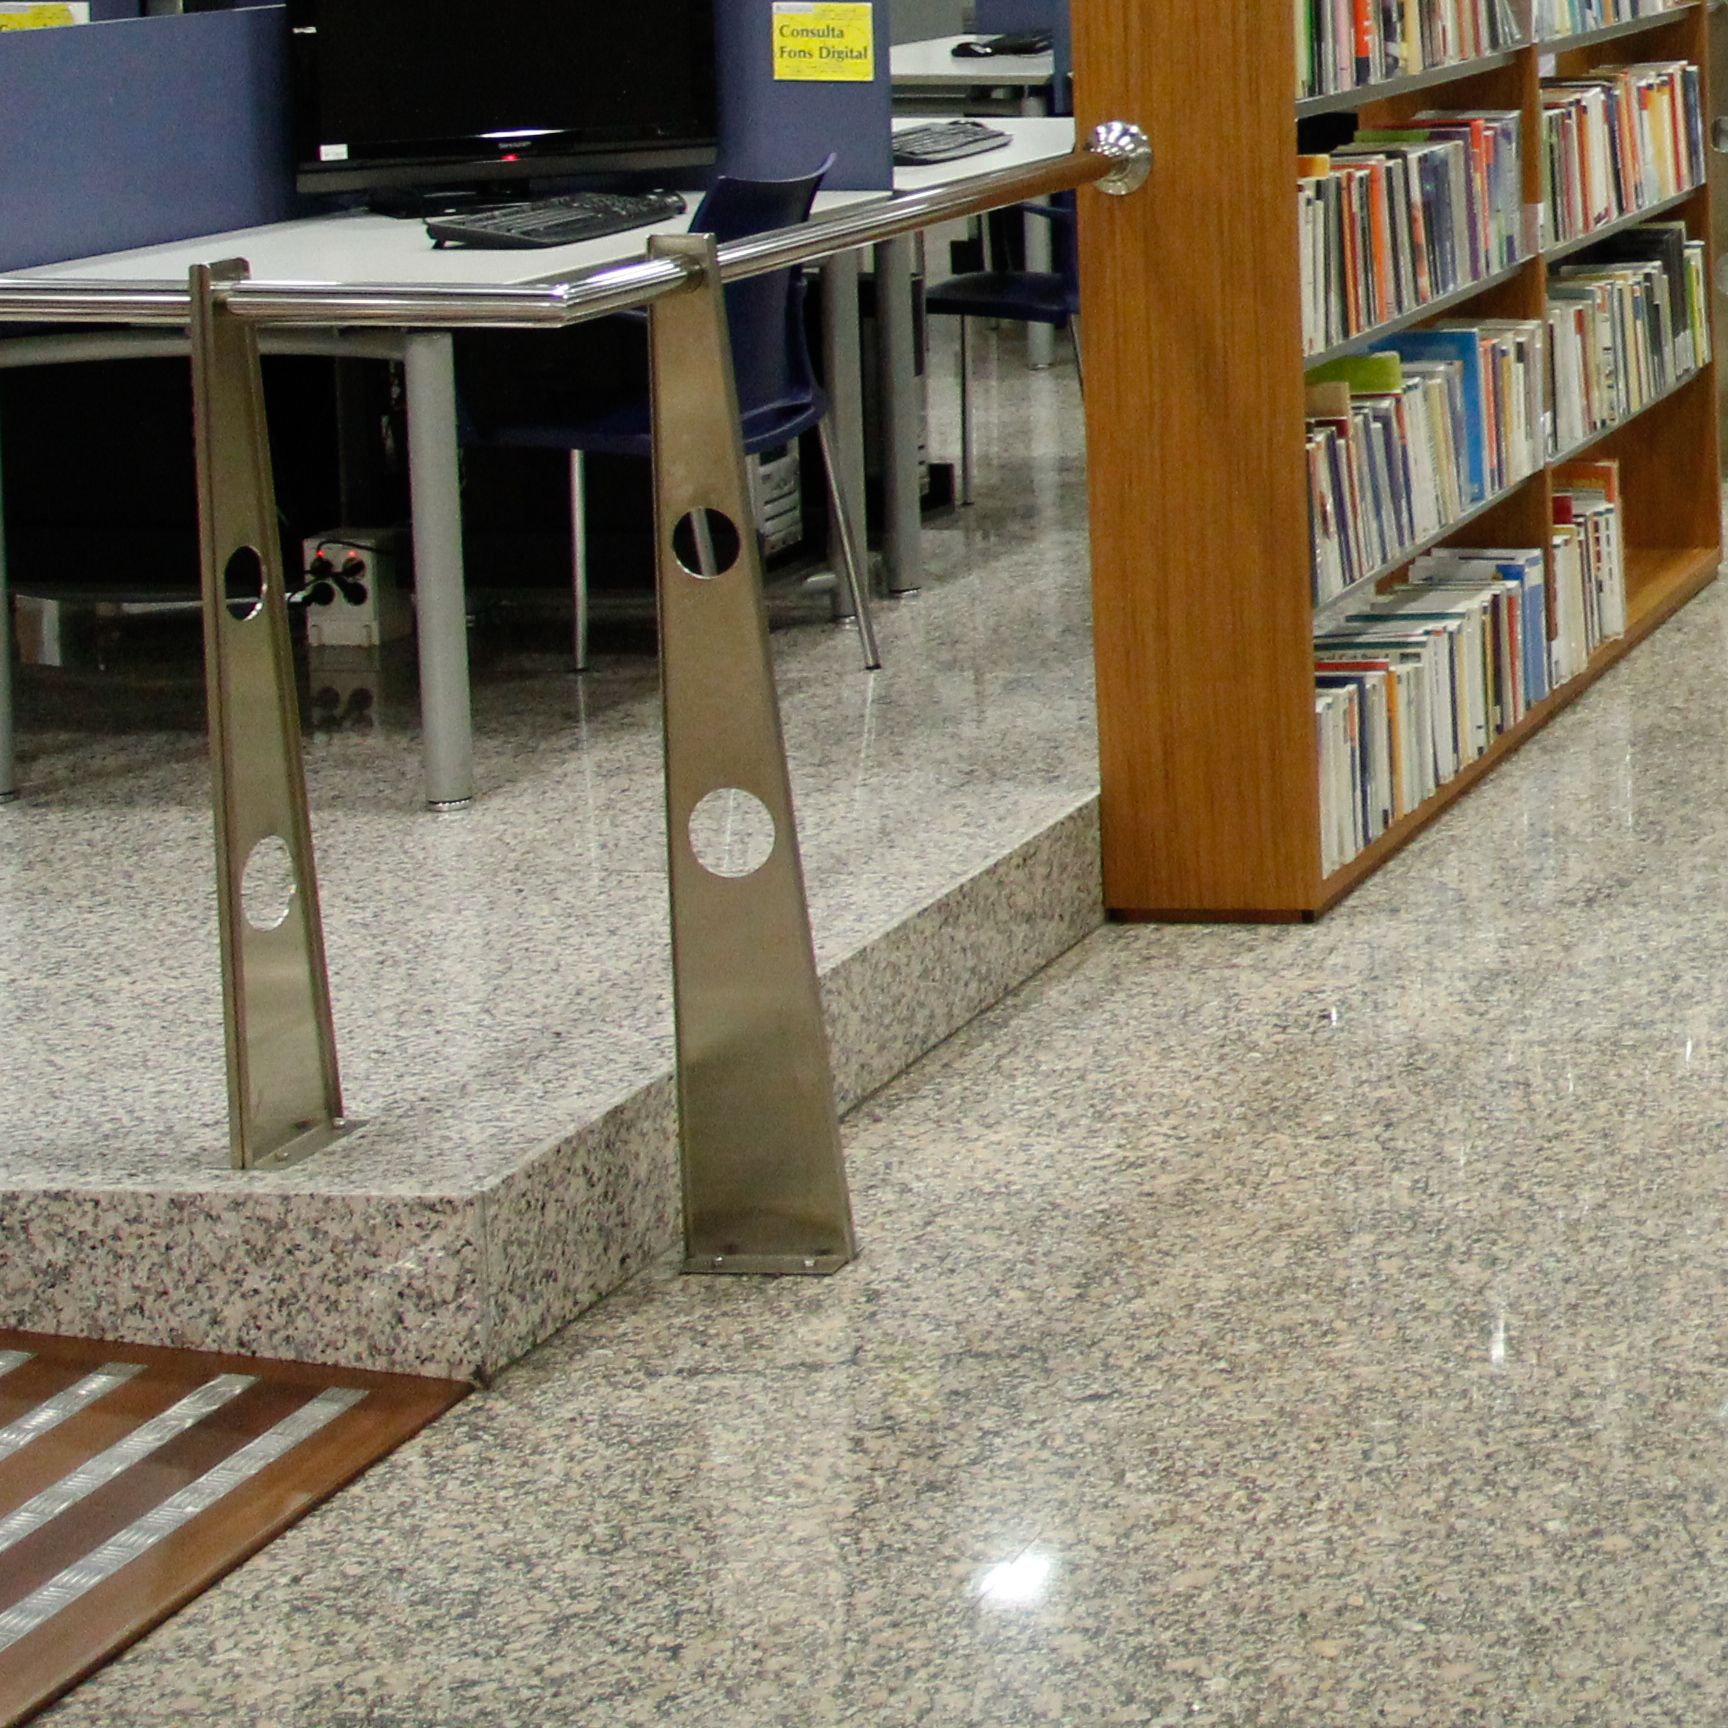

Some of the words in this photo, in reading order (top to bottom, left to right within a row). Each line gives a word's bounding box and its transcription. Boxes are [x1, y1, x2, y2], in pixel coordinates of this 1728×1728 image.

[779, 24, 845, 39] Consulta
[779, 46, 815, 60] Fons
[818, 46, 868, 62] Digital
